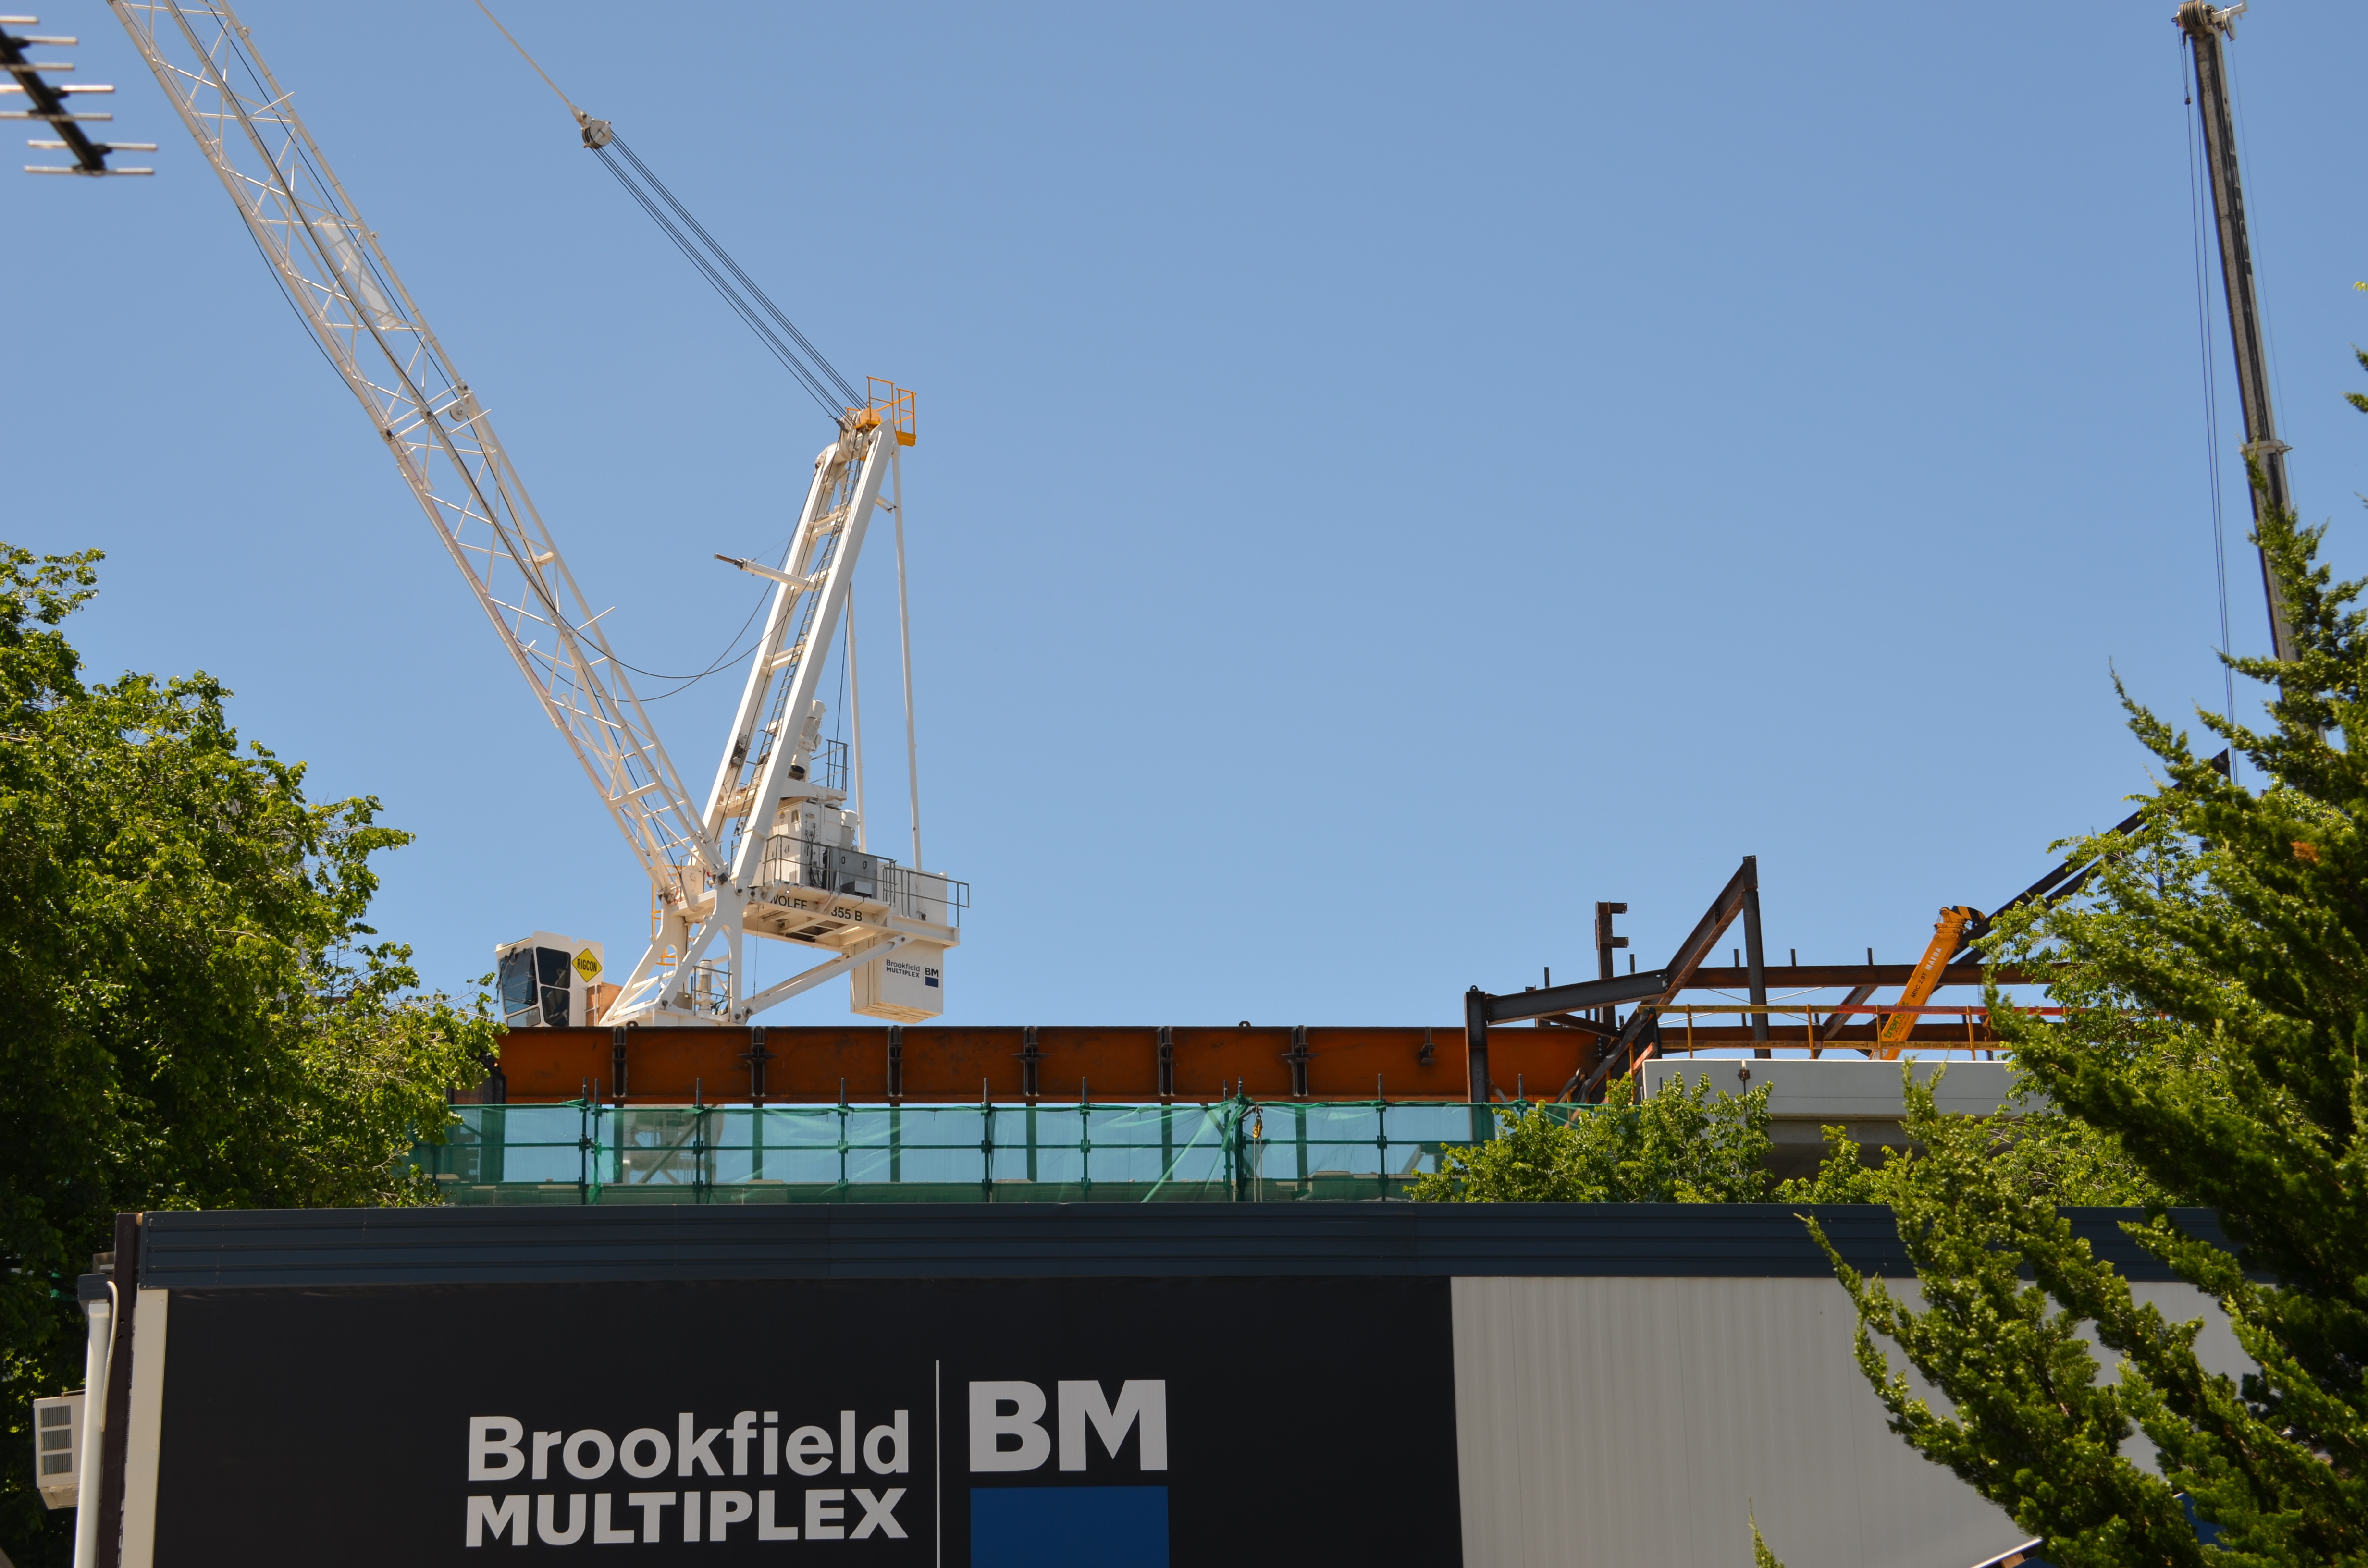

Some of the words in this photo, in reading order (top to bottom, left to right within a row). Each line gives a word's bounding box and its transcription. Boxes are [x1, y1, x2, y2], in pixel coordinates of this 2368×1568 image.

[855, 910, 863, 922] B
[577, 958, 597, 973] RIGCON
[886, 959, 920, 972] Brookfield
[1924, 948, 1942, 971] MAEDA
[886, 967, 920, 978] MULTIPLEX
[925, 967, 939, 978] BM
[1911, 984, 1921, 998] MRC
[1918, 972, 1927, 985] 2.9T
[968, 1379, 1168, 1472] BM
[468, 1409, 909, 1481] Brookfield
[466, 1487, 909, 1547] MULTIPLEX
